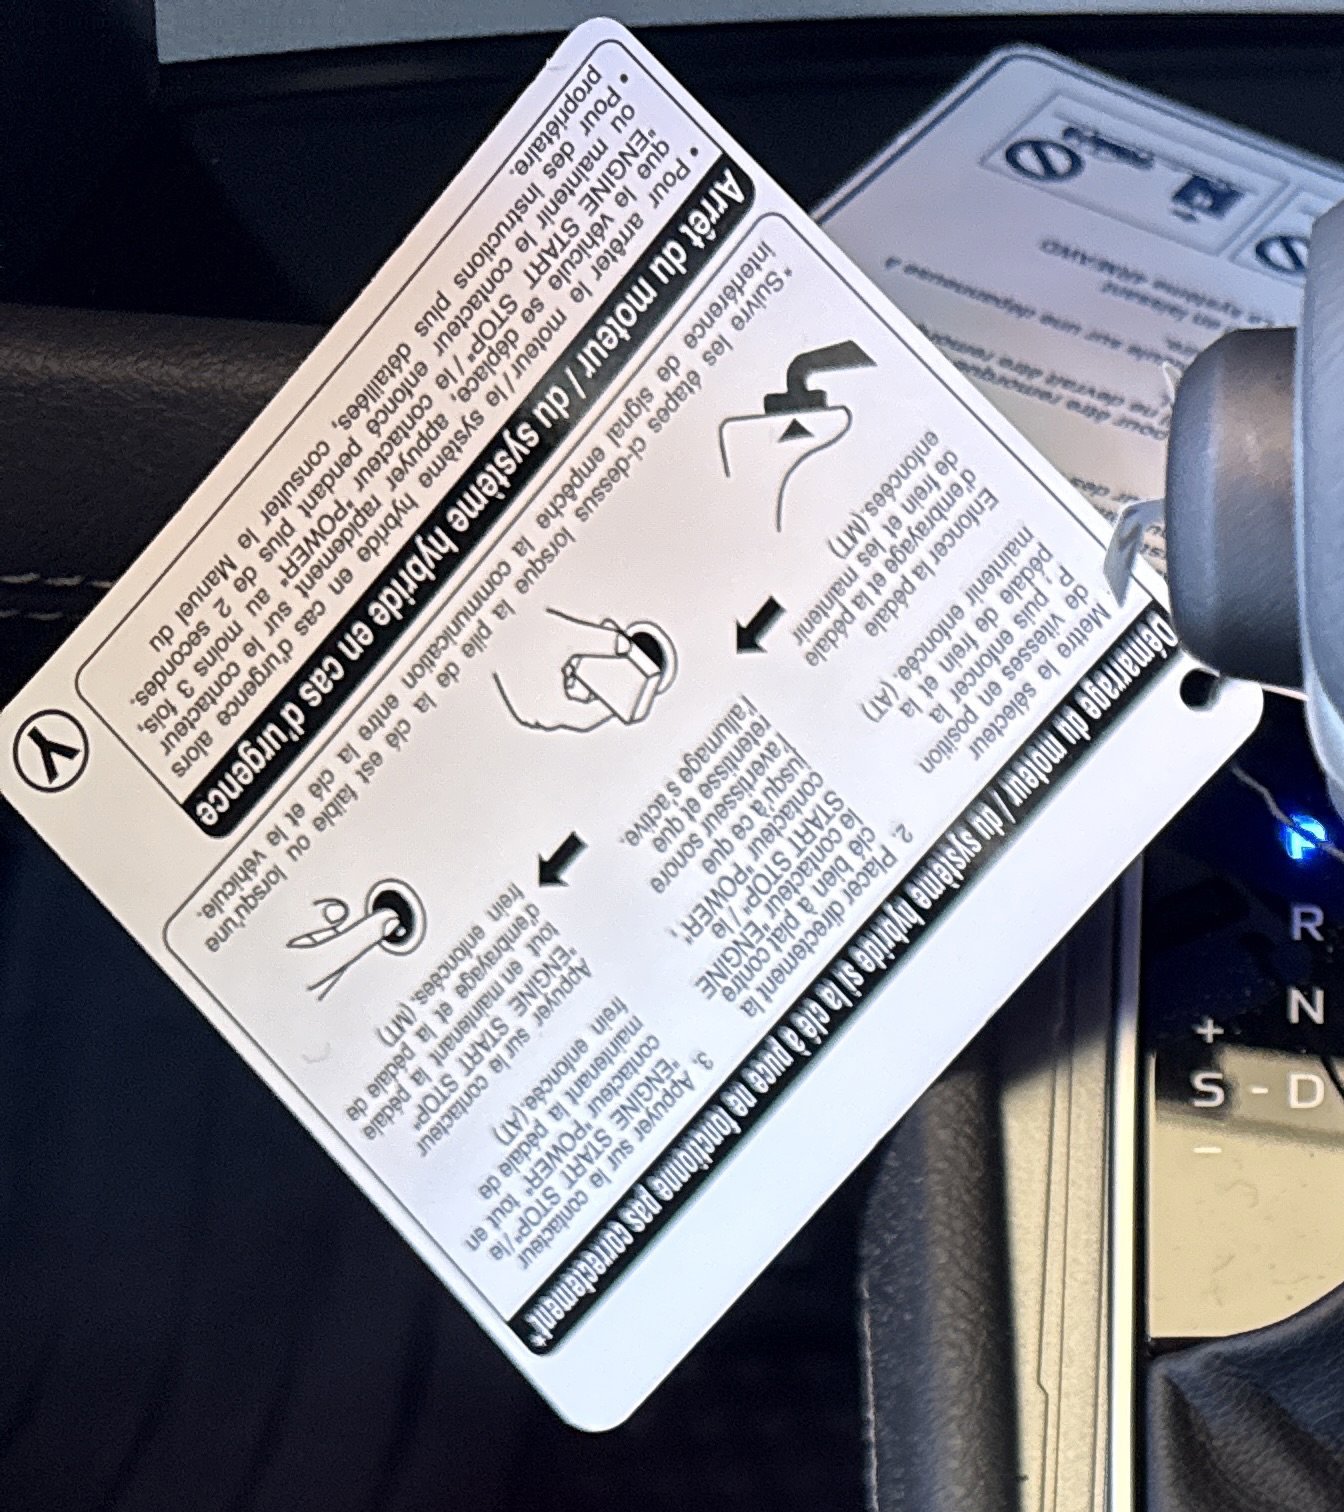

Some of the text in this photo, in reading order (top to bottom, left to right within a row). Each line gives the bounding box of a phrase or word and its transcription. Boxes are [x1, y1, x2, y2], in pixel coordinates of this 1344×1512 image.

[508, 58, 603, 176] propriétaire.
[521, 216, 580, 291] START
[147, 84, 622, 653] Pour des instructions plus détaillées, consulter le Manuel du
[434, 366, 459, 390] le
[701, 333, 734, 367] les
[129, 103, 635, 707] ou maintenir le contacteur enfoncé pendant plus de 2 secondes.
[646, 368, 702, 434] étapes
[159, 139, 670, 757] que le véhicule se déplace, appuyer rapidement sur le contacteur
[170, 156, 691, 778] Pour arrêter le moteur le système hybride en cas d'urgence alors
[352, 393, 433, 493] contacteur
[195, 167, 745, 826] Arrêt du moteur du système hybride en cas d'urgence
[573, 435, 647, 523] ci-dessus
[513, 524, 577, 595] lorsque
[244, 586, 271, 617] au
[490, 597, 516, 621] la
[859, 525, 1035, 723] maintenir enfoncée. (AT)
[897, 540, 1054, 718] pédale de frein et la
[1012, 584, 1050, 629] puis
[192, 618, 244, 678] moins
[459, 617, 493, 659] pile
[1063, 600, 1179, 720] Démarrage
[175, 678, 195, 699] 3
[435, 660, 460, 688] de
[917, 583, 1089, 774] de vitesses en position
[948, 628, 1014, 708] enfoncer
[967, 601, 1111, 761] Mettre le sélecteur
[136, 697, 179, 734] fois,
[411, 690, 438, 714] la
[927, 702, 954, 724] la
[1053, 705, 1091, 745] du
[384, 717, 411, 752] clé
[353, 750, 383, 784] est
[1000, 731, 1068, 807] moteur
[310, 782, 359, 833] faible
[746, 770, 824, 862] contacteur
[786, 789, 845, 859] START
[838, 806, 864, 830] le
[969, 802, 1006, 841] du
[284, 833, 311, 862] ou
[763, 826, 843, 920] contacteur
[841, 843, 898, 906] Placer
[906, 825, 983, 910] système
[203, 863, 288, 953] lorsqu'une
[710, 916, 735, 939] le
[720, 825, 876, 1003] clé bien à plat contre
[850, 897, 926, 973] hybride
[1290, 904, 1325, 942] R
[754, 899, 845, 1003] directement
[832, 961, 865, 998] si
[738, 994, 765, 1018] la
[791, 998, 831, 1045] clé
[815, 979, 854, 1011] la
[1288, 986, 1325, 1025] N
[742, 1035, 794, 1094] puce
[779, 1025, 812, 1056] à
[632, 1069, 695, 1142] Appuyer
[721, 1082, 758, 1117] ne
[1191, 1072, 1325, 1109] S D
[588, 1166, 612, 1188] le
[606, 1138, 634, 1171] sur
[647, 1105, 742, 1201] fonctionne
[516, 1189, 589, 1270] contacteur
[619, 1183, 663, 1232] pas
